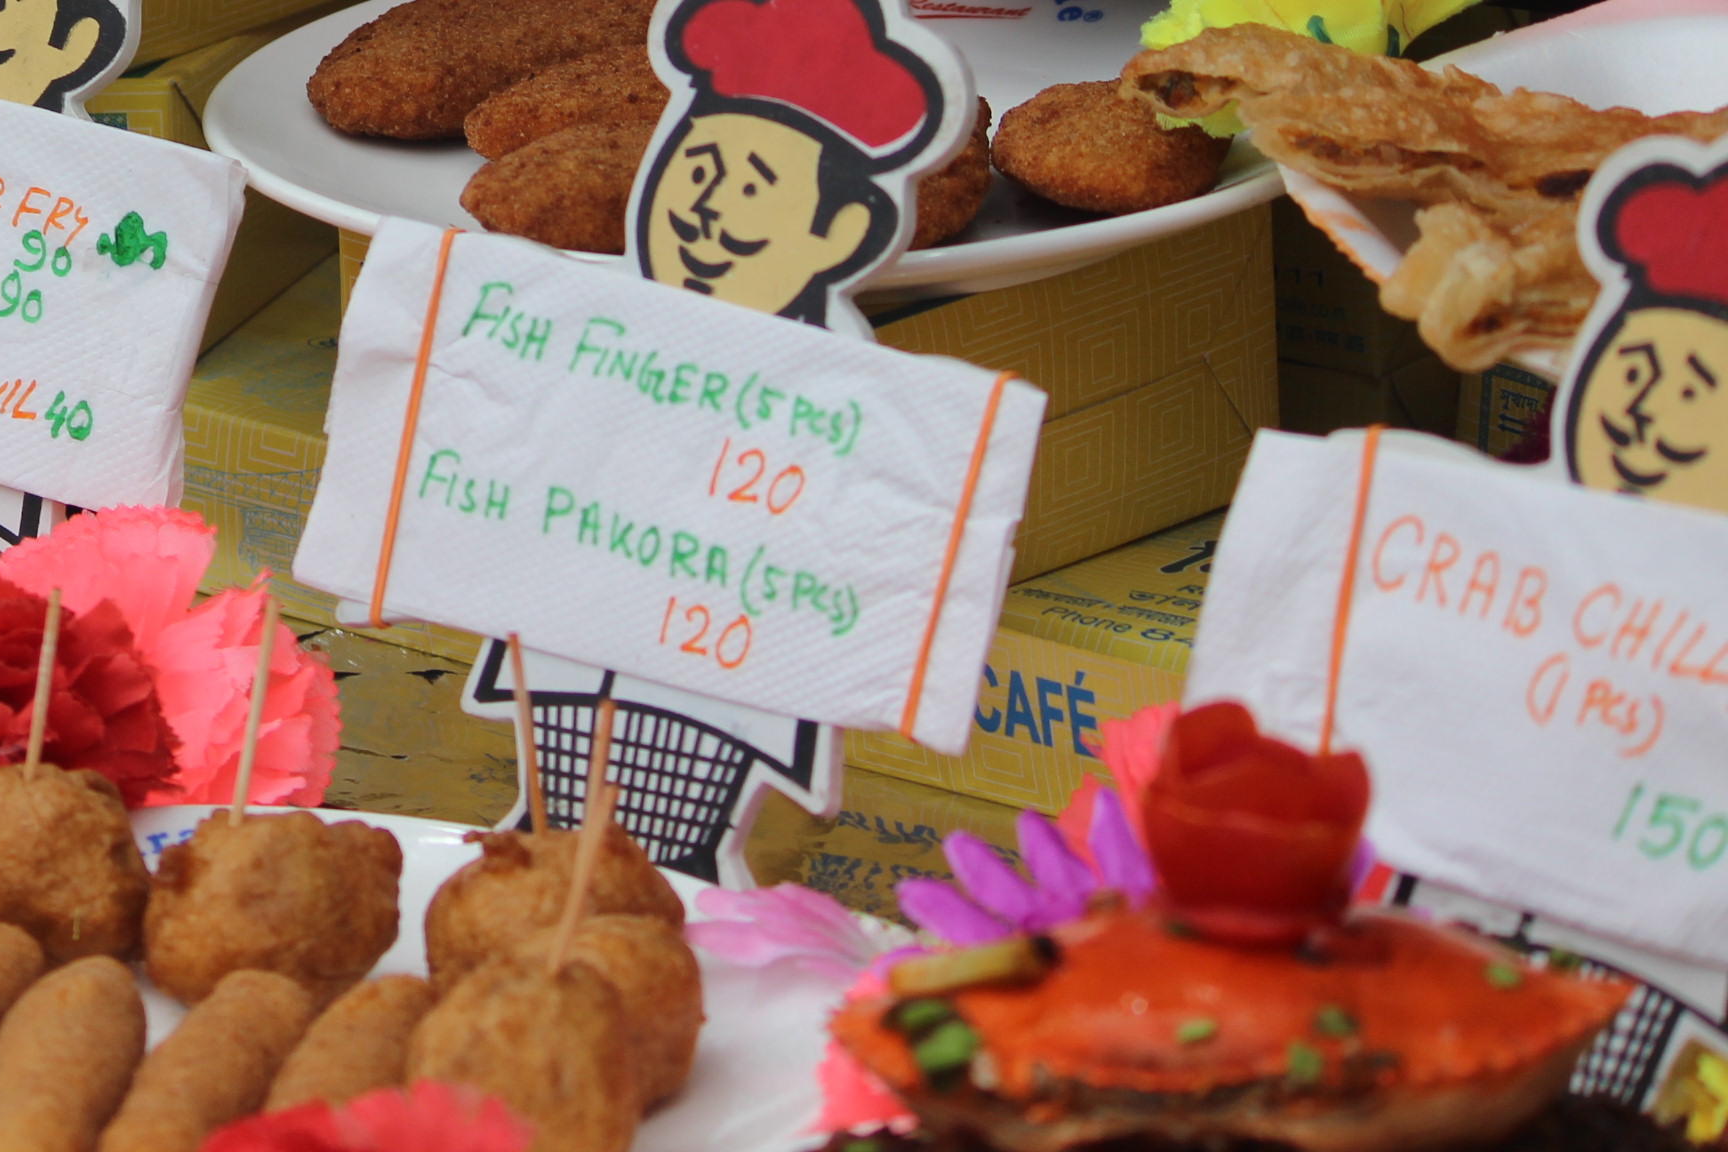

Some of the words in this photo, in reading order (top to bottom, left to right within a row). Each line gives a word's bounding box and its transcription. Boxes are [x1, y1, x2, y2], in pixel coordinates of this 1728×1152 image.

[11, 185, 90, 247] FRY
[14, 228, 73, 278] 90
[462, 282, 553, 361] FISH
[570, 317, 728, 413] FINGER
[44, 389, 95, 442] 40
[709, 436, 805, 514] 120
[419, 450, 510, 521] FISH
[542, 485, 728, 588] PAKORA
[658, 595, 753, 670] 120
[1041, 606, 1133, 634] Phone
[1372, 513, 1549, 638] CRAB
[1571, 580, 1728, 686] CHILL
[1610, 779, 1728, 872] 150
